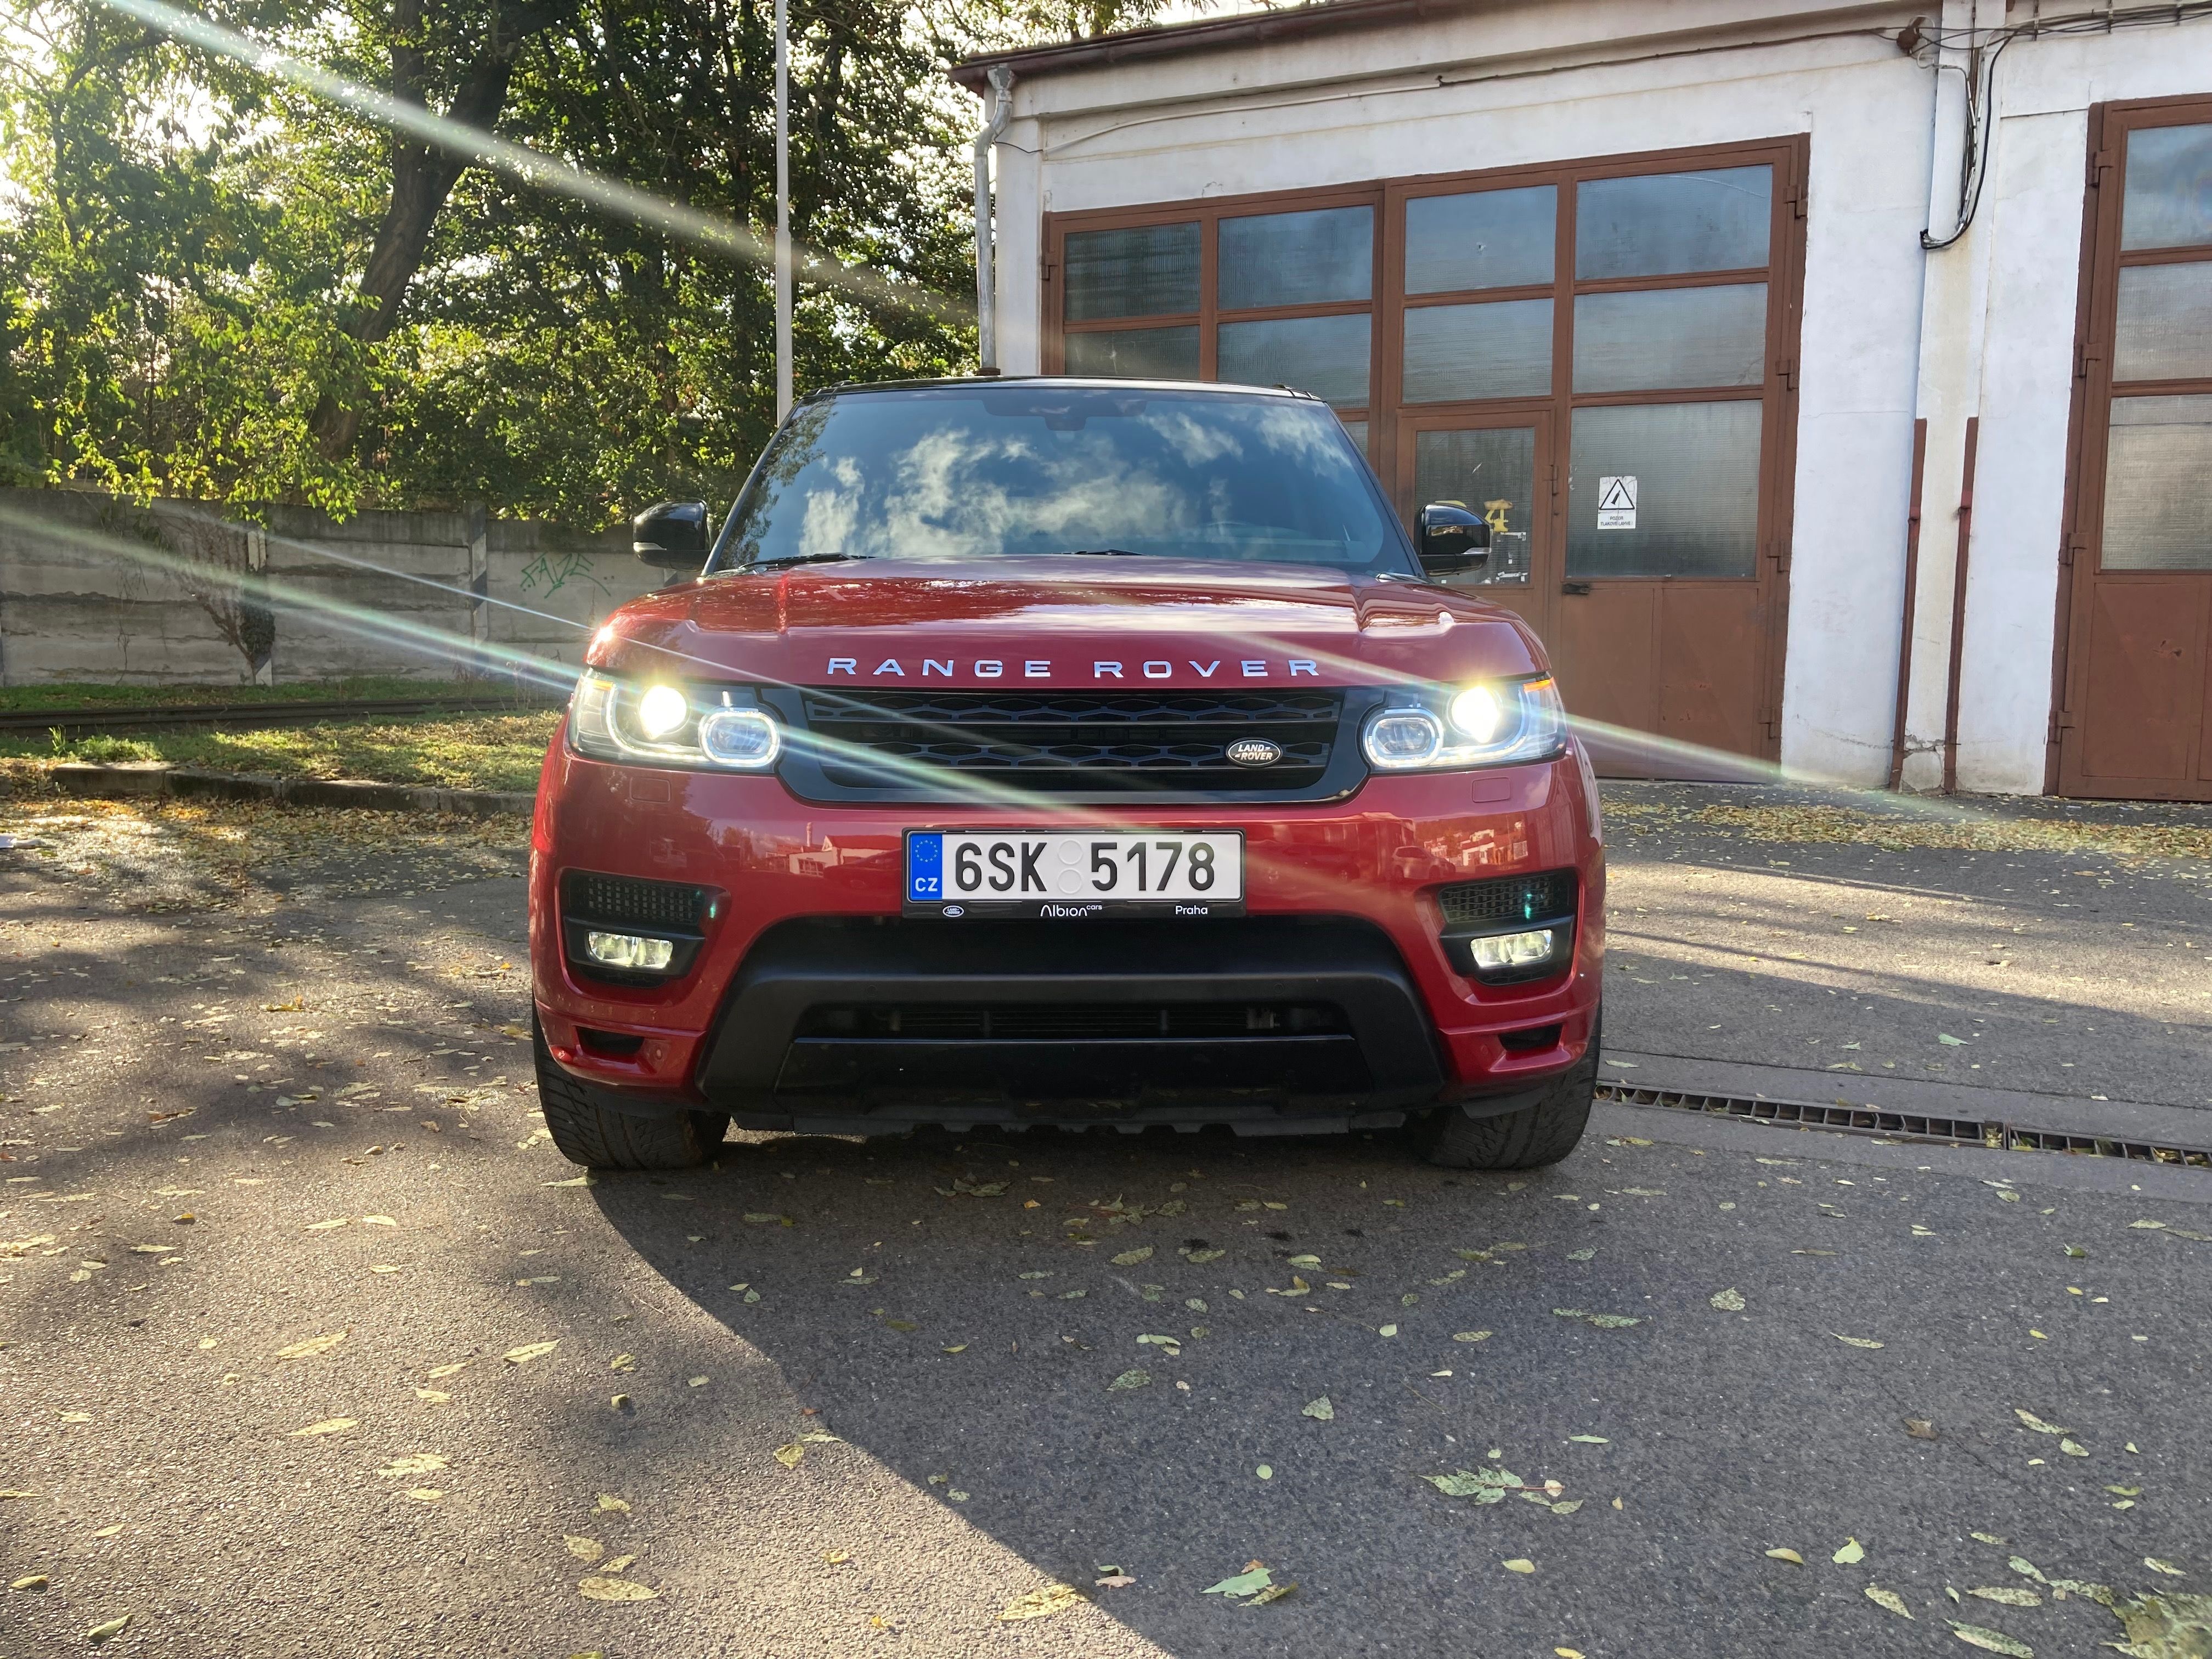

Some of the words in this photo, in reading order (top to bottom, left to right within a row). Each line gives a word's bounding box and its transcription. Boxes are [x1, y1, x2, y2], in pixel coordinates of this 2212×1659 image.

[827, 658, 1051, 678] RANGE
[1094, 659, 1319, 678] ROVER
[1238, 744, 1265, 752] LAND
[1240, 752, 1273, 760] ROVER
[955, 842, 1047, 891] 6SK
[1091, 842, 1215, 891] 5178
[915, 877, 938, 892] CZ
[1040, 904, 1087, 917] Albion
[1175, 905, 1208, 915] Praha
